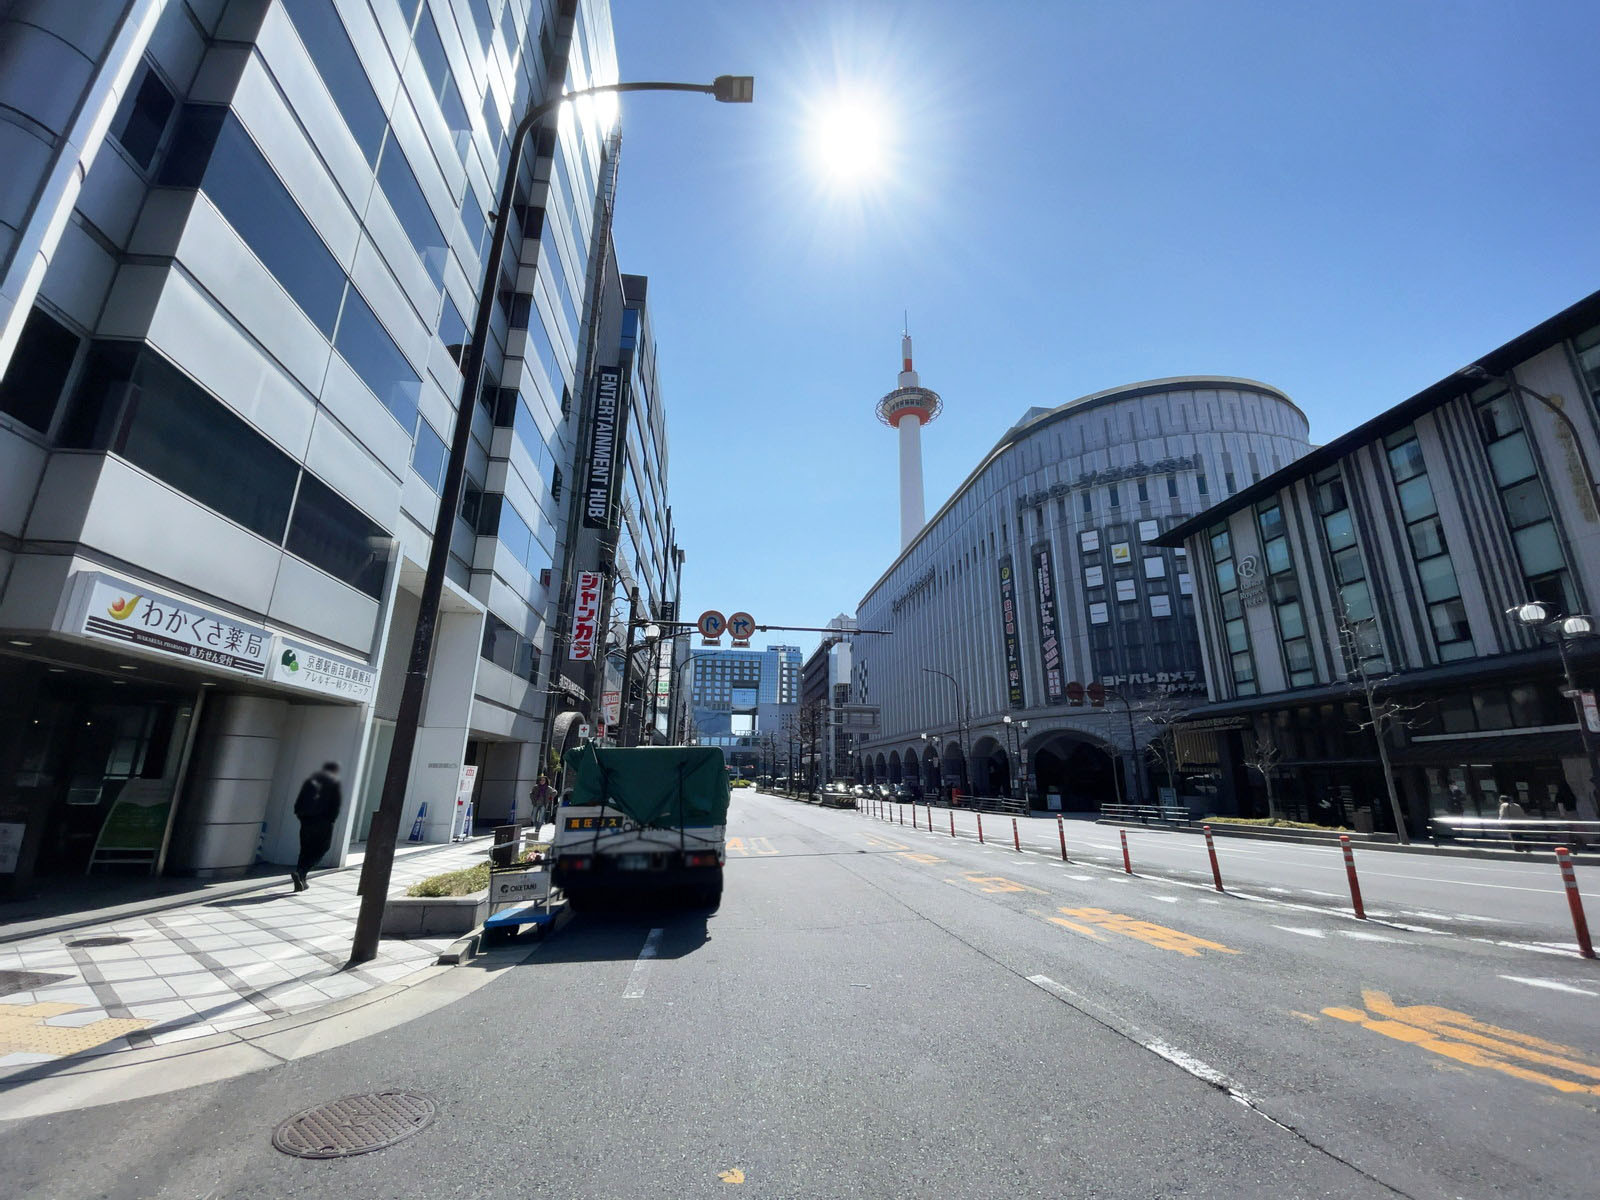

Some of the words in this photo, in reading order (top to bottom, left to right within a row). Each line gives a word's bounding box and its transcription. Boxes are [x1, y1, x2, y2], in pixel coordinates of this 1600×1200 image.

[591, 372, 618, 486] ENTERTAINMENT
[587, 488, 608, 519] HUB
[141, 600, 263, 659] わかくさ薬局
[573, 573, 599, 659] ジャンカラ
[188, 646, 234, 667] 処方せん受付
[306, 655, 372, 685] 京都駅前耳鼻咽喉科
[304, 671, 369, 696] アレルギー科クリニック
[1102, 670, 1198, 687] ヨドバシカメラ
